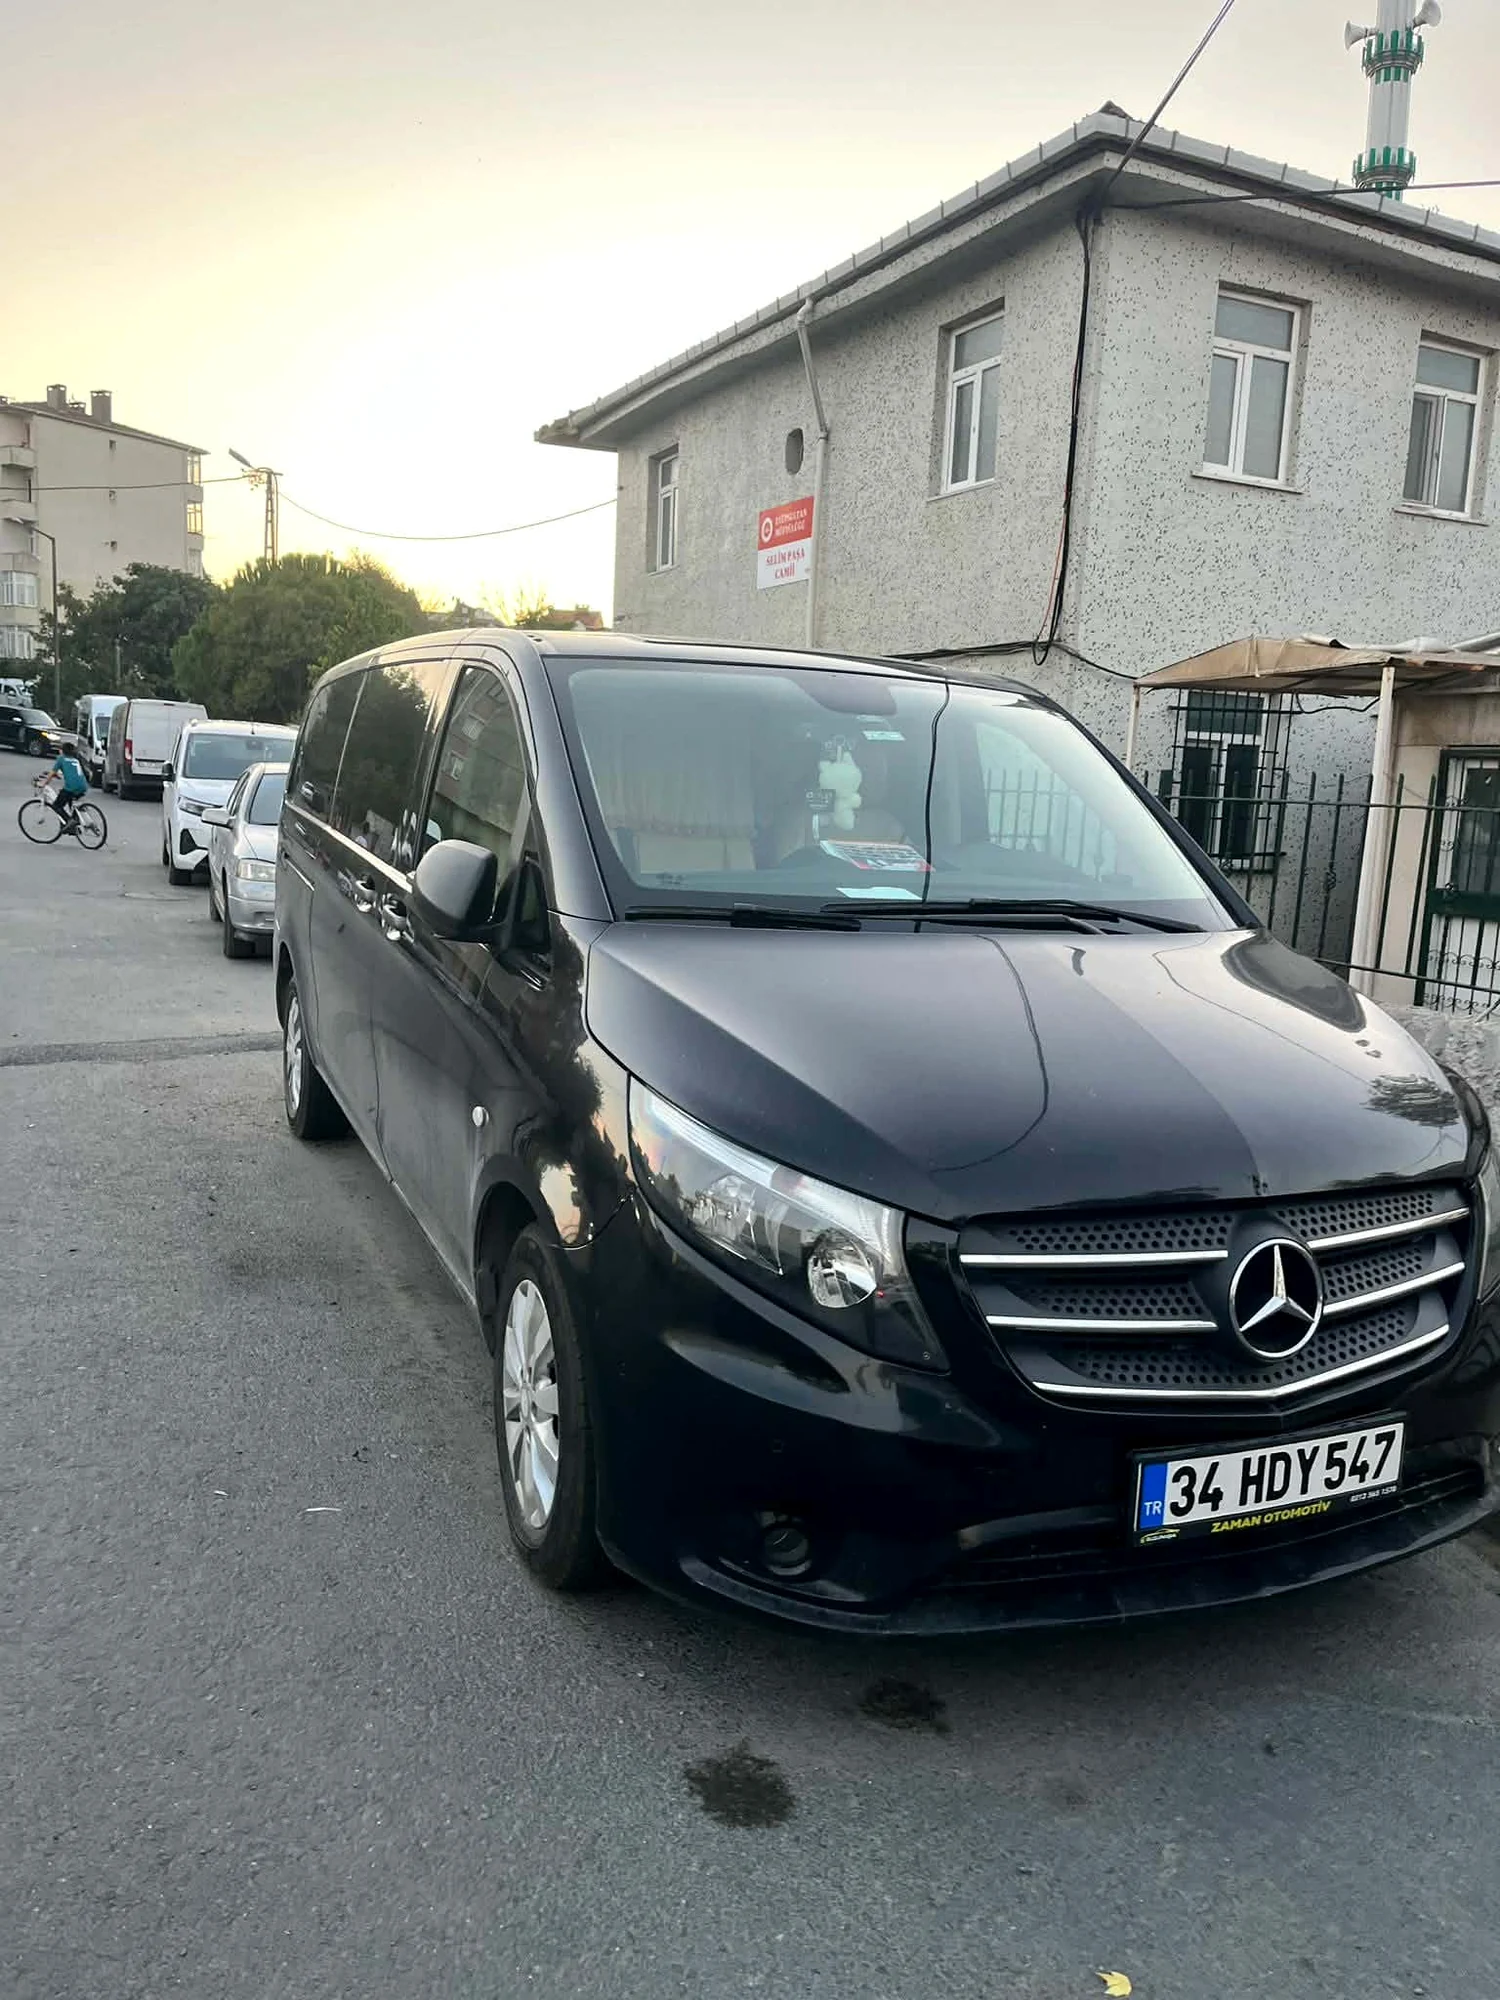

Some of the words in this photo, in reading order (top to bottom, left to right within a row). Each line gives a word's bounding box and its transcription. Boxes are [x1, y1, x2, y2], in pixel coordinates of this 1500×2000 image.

[1144, 1501, 1162, 1517] TR
[1169, 1462, 1223, 1517] 34
[1211, 1515, 1261, 1533] ZAMAN
[1263, 1500, 1332, 1523] OTOMOTİV
